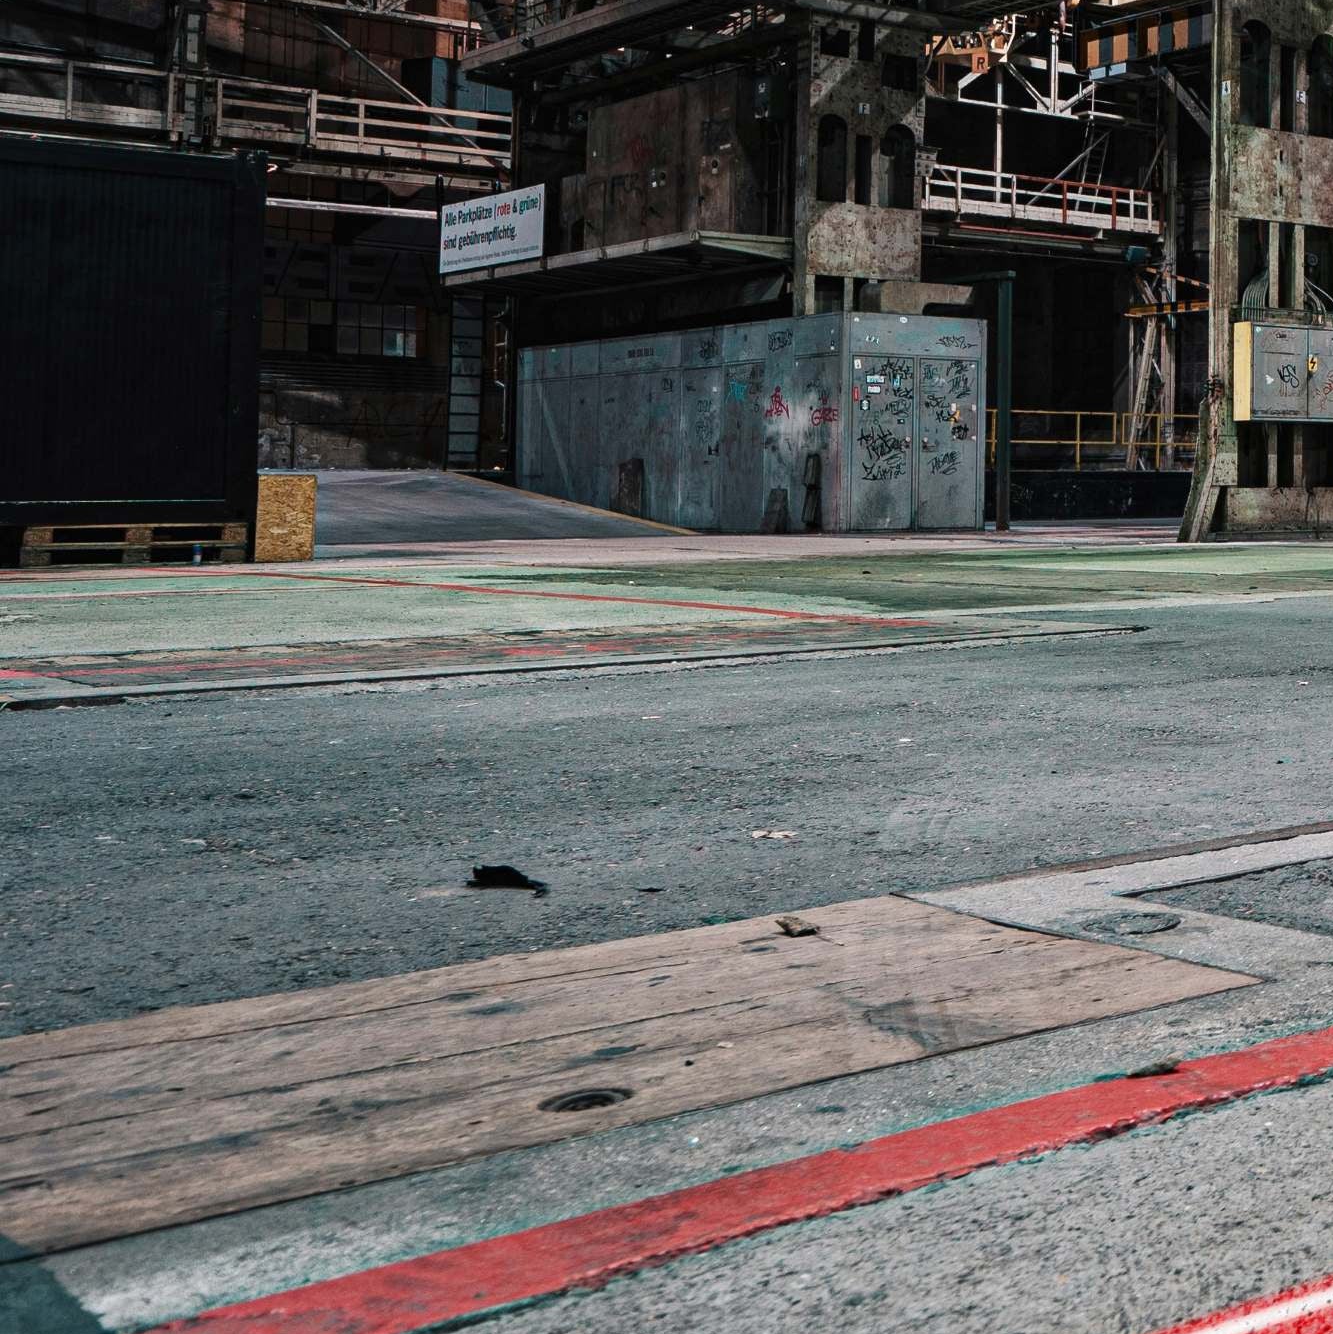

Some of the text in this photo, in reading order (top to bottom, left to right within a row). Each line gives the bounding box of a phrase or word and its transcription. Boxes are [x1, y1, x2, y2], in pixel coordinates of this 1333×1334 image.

[976, 56, 986, 70] R
[445, 212, 456, 227] Alle
[458, 206, 493, 225] Parkplätze
[512, 198, 517, 214] &
[519, 193, 542, 215] grüne)
[443, 223, 518, 250] sind gebührenpflichtig.
